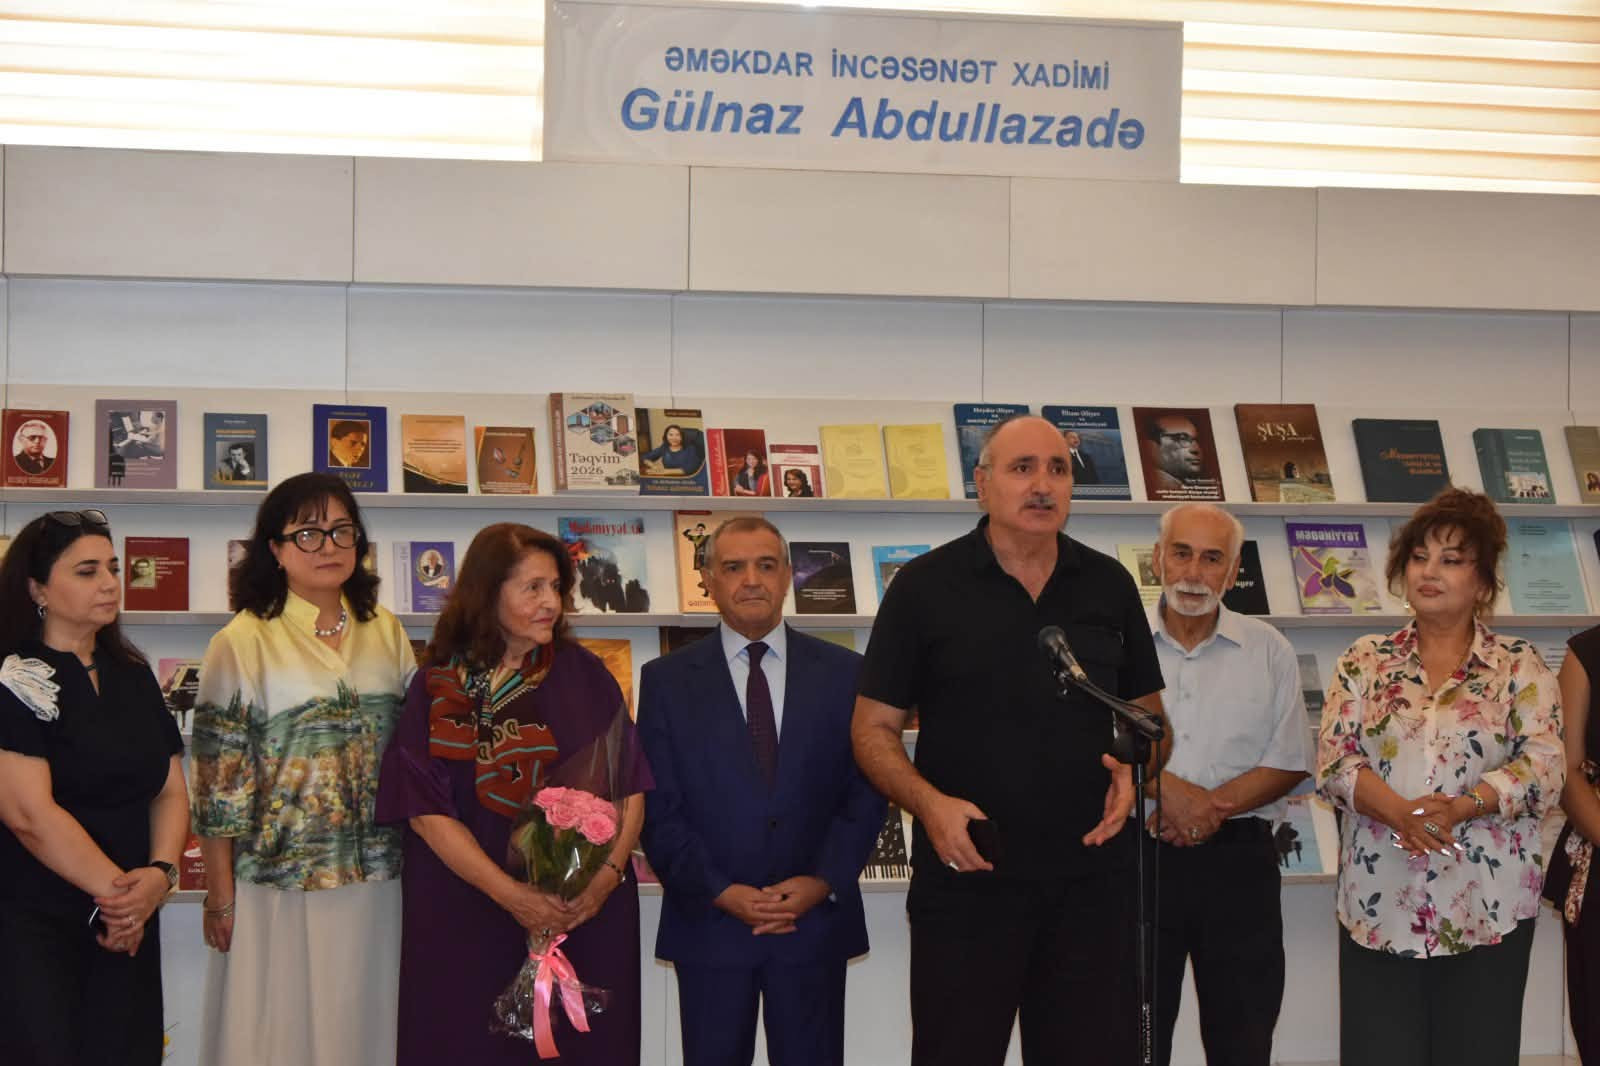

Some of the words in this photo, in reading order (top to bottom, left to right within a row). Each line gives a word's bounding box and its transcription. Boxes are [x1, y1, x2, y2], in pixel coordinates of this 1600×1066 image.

[665, 47, 814, 76] ƏMƏKDAR
[831, 48, 997, 84] İNCƏSƏNƏT
[1011, 60, 1109, 90] XADİMİ
[620, 87, 804, 135] Gülnaz
[832, 97, 1145, 149] Abdullazadə
